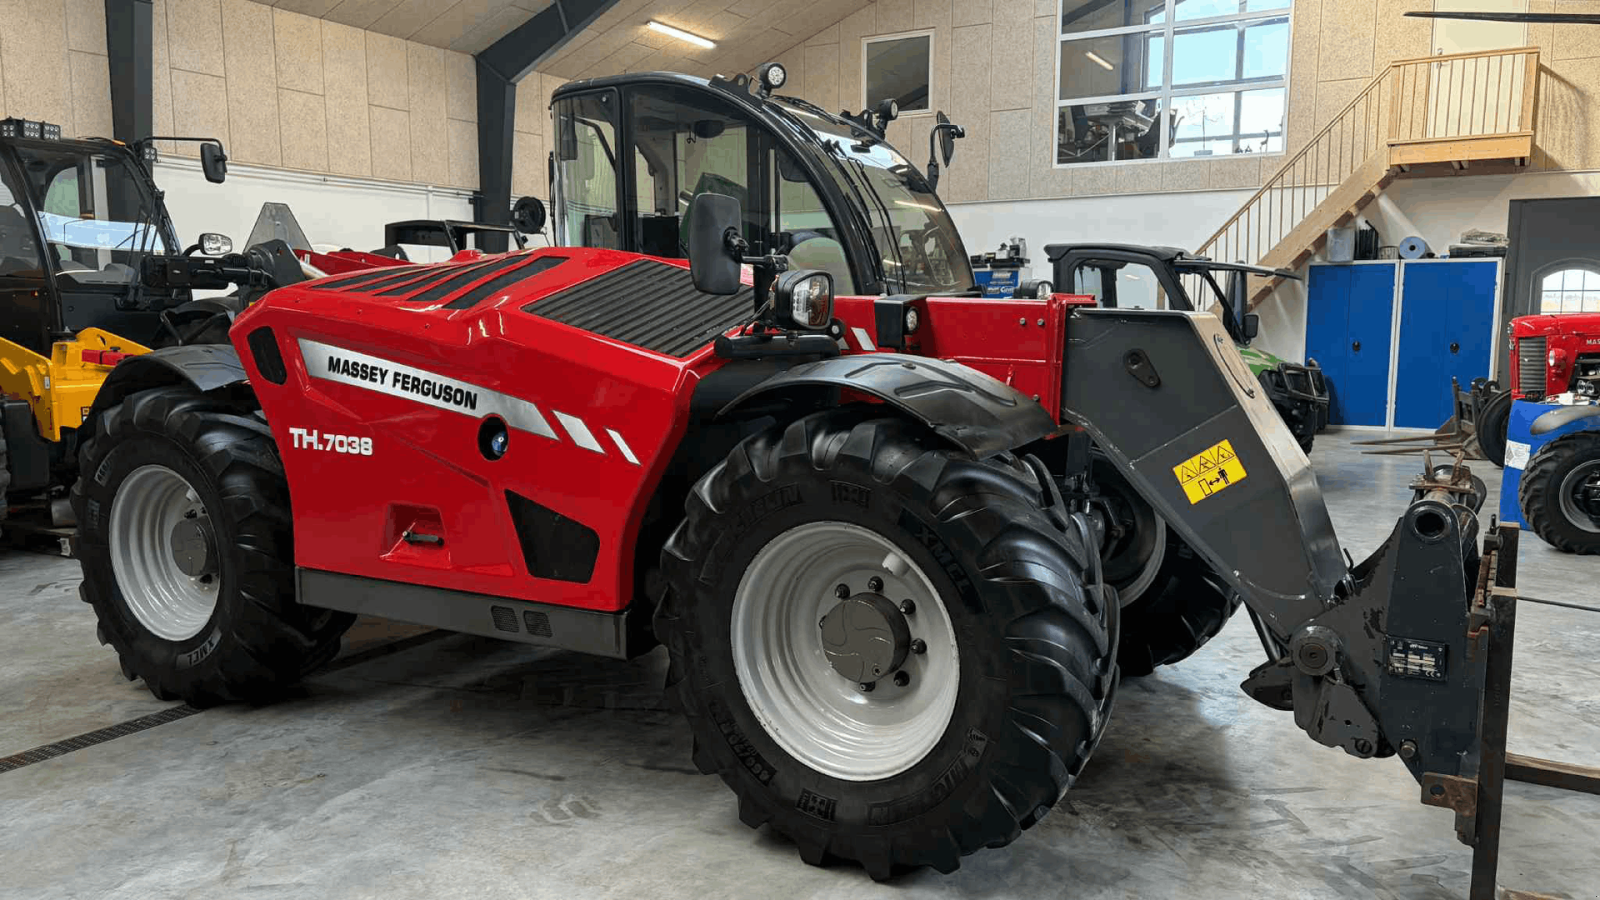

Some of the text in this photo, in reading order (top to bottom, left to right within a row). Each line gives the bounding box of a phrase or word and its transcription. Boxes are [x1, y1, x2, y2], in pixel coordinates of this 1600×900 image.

[328, 356, 478, 410] MASSEY FERGUSON
[289, 427, 374, 456] TH.7038
